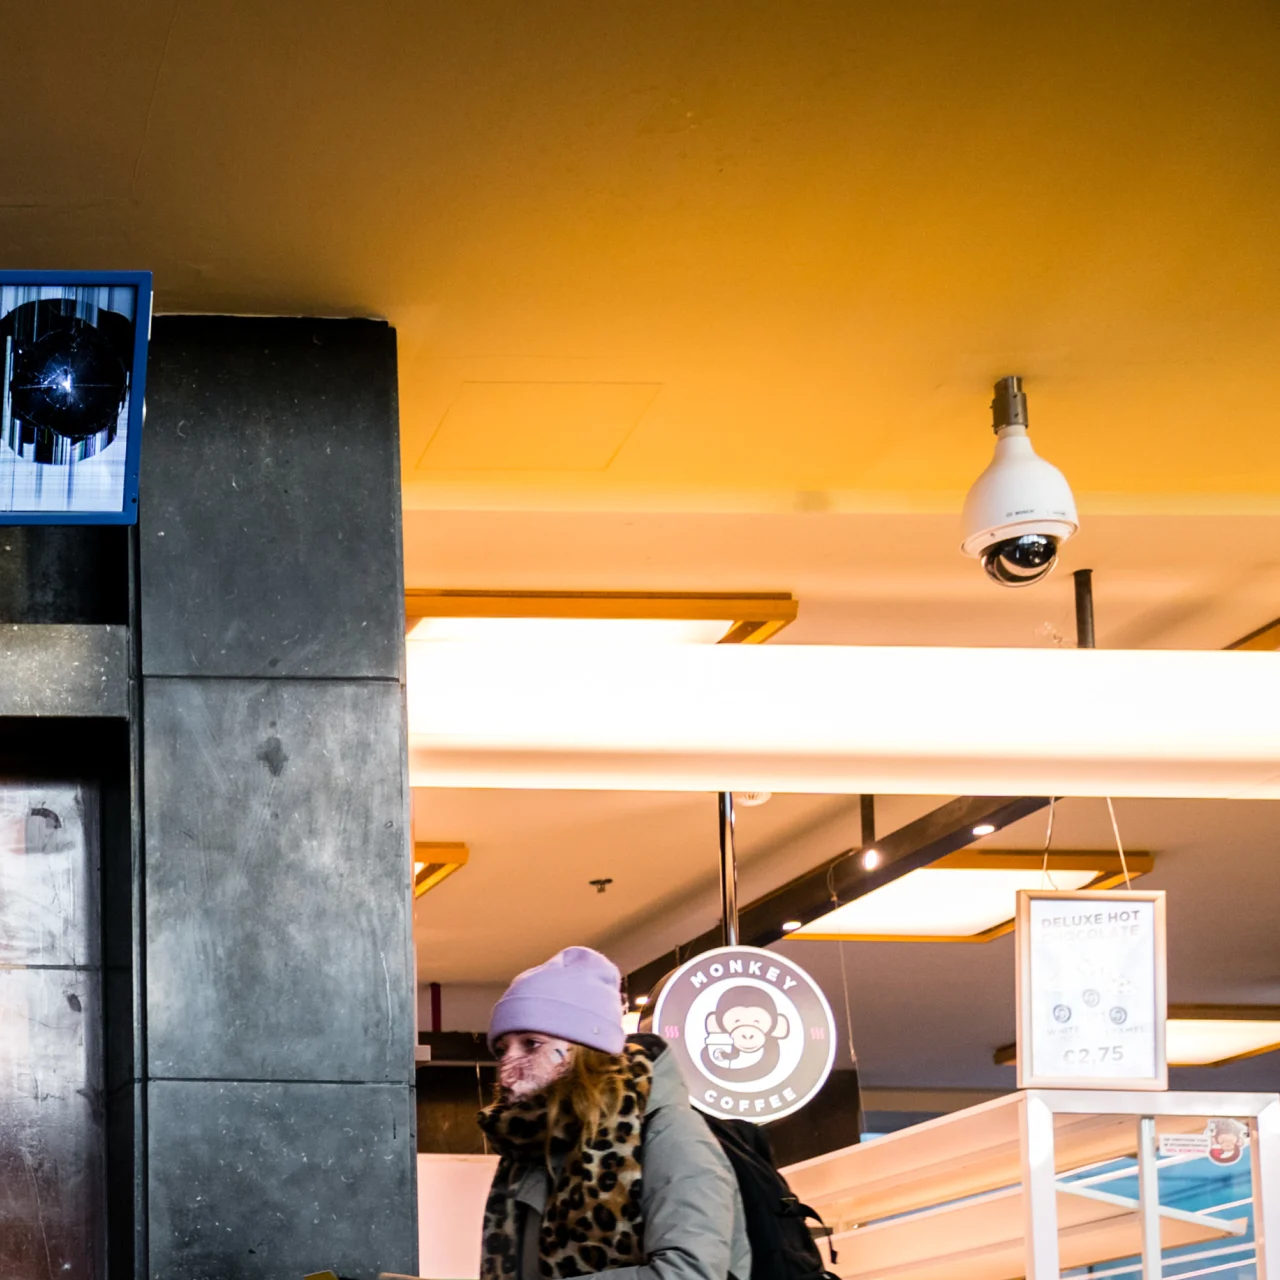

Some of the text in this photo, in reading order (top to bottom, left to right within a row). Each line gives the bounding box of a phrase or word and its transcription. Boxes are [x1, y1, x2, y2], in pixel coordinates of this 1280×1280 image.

[1041, 909, 1141, 929] DELUXE HOT
[689, 959, 798, 991] MONKEY
[703, 1086, 798, 1112] COFFEE
